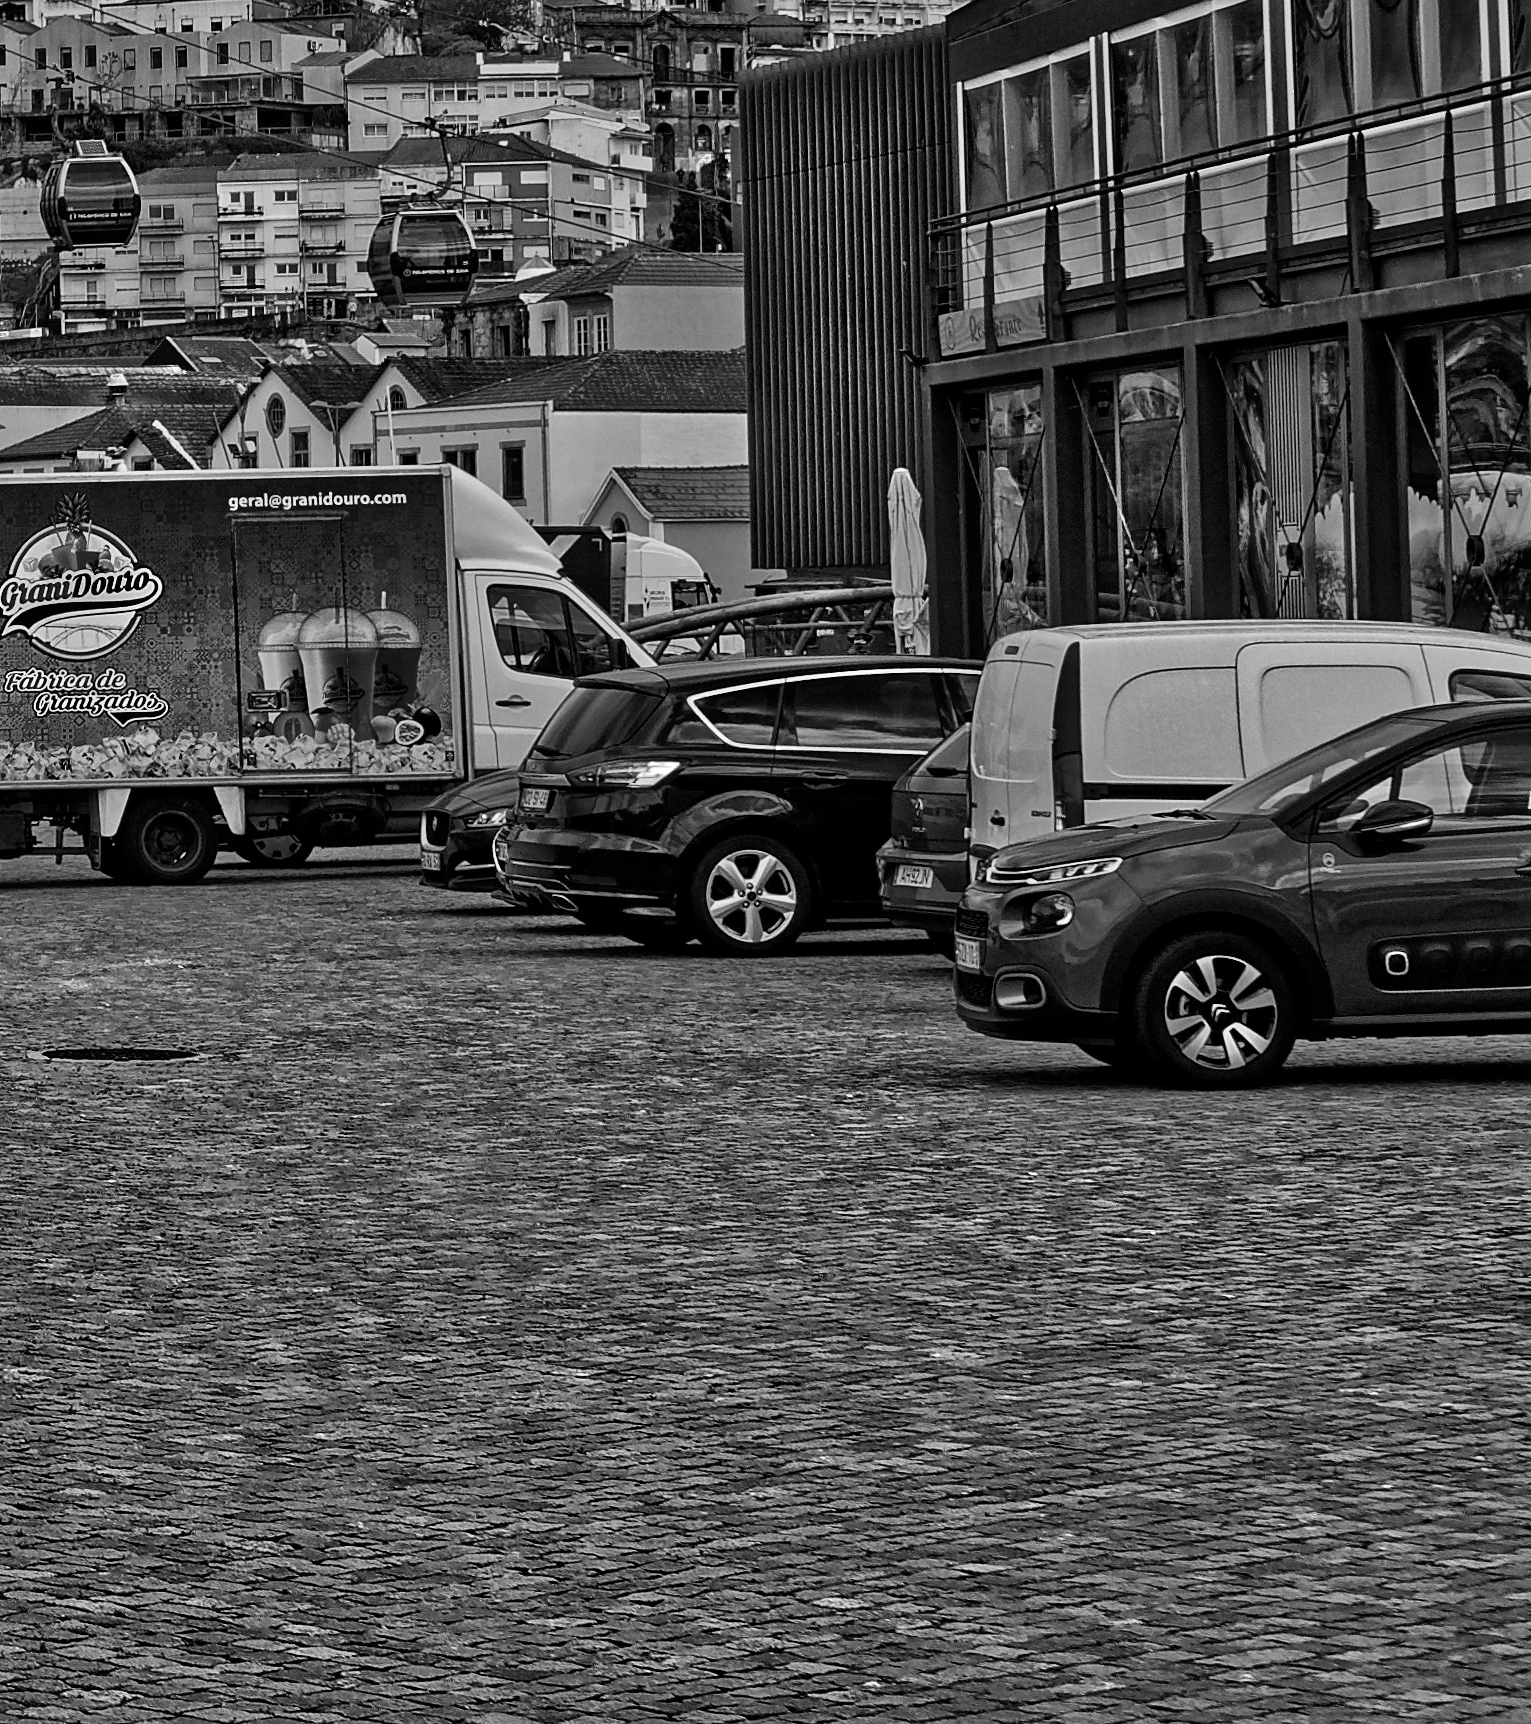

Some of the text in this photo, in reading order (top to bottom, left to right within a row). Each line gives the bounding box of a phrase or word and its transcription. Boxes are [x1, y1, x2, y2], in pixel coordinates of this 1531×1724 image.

[228, 492, 407, 511] geral@granidouro.com
[0, 569, 151, 612] GraniDouro
[5, 667, 126, 692] Fábrica de
[34, 689, 163, 717] Granizados
